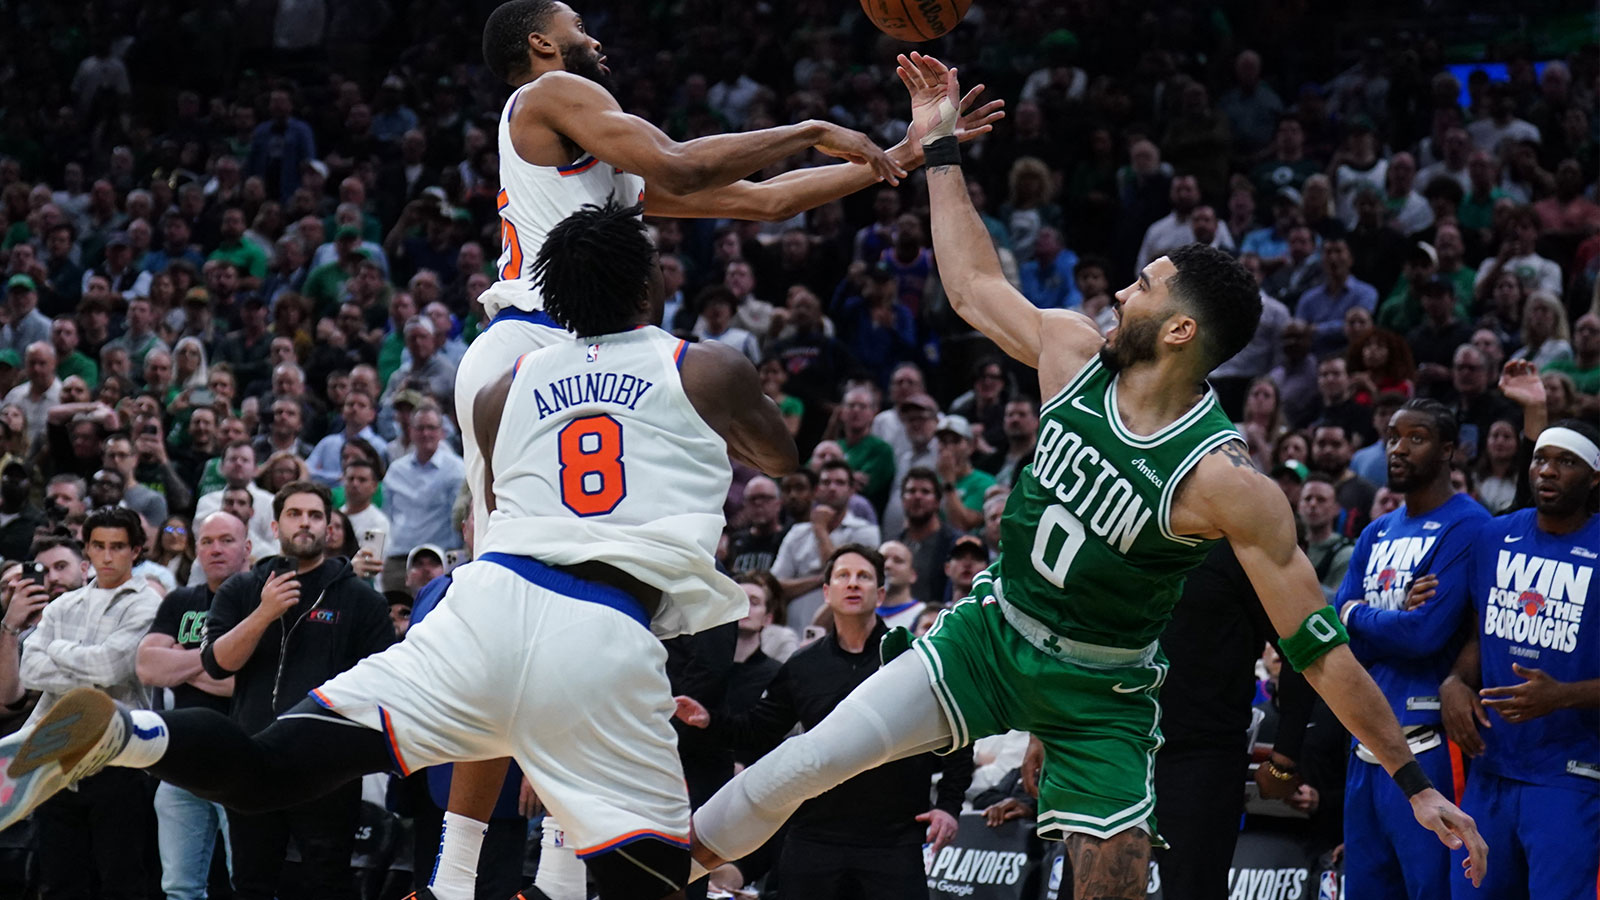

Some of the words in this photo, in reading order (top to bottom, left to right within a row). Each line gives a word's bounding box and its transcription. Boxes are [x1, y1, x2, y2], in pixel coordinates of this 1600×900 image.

[533, 372, 653, 420] ANUNOBY
[557, 412, 627, 518] 8
[1032, 418, 1153, 555] BOSTON
[1131, 458, 1163, 489] Amica
[1030, 503, 1087, 589] 0
[1365, 535, 1437, 577] WIN
[1496, 549, 1594, 605] WIN
[1488, 586, 1519, 610] FOR
[1545, 599, 1584, 624] THE
[1306, 613, 1337, 643] 0
[1484, 604, 1580, 654] BOROUGHS
[930, 845, 1028, 886] PLAYOFFS
[937, 879, 974, 897] Google
